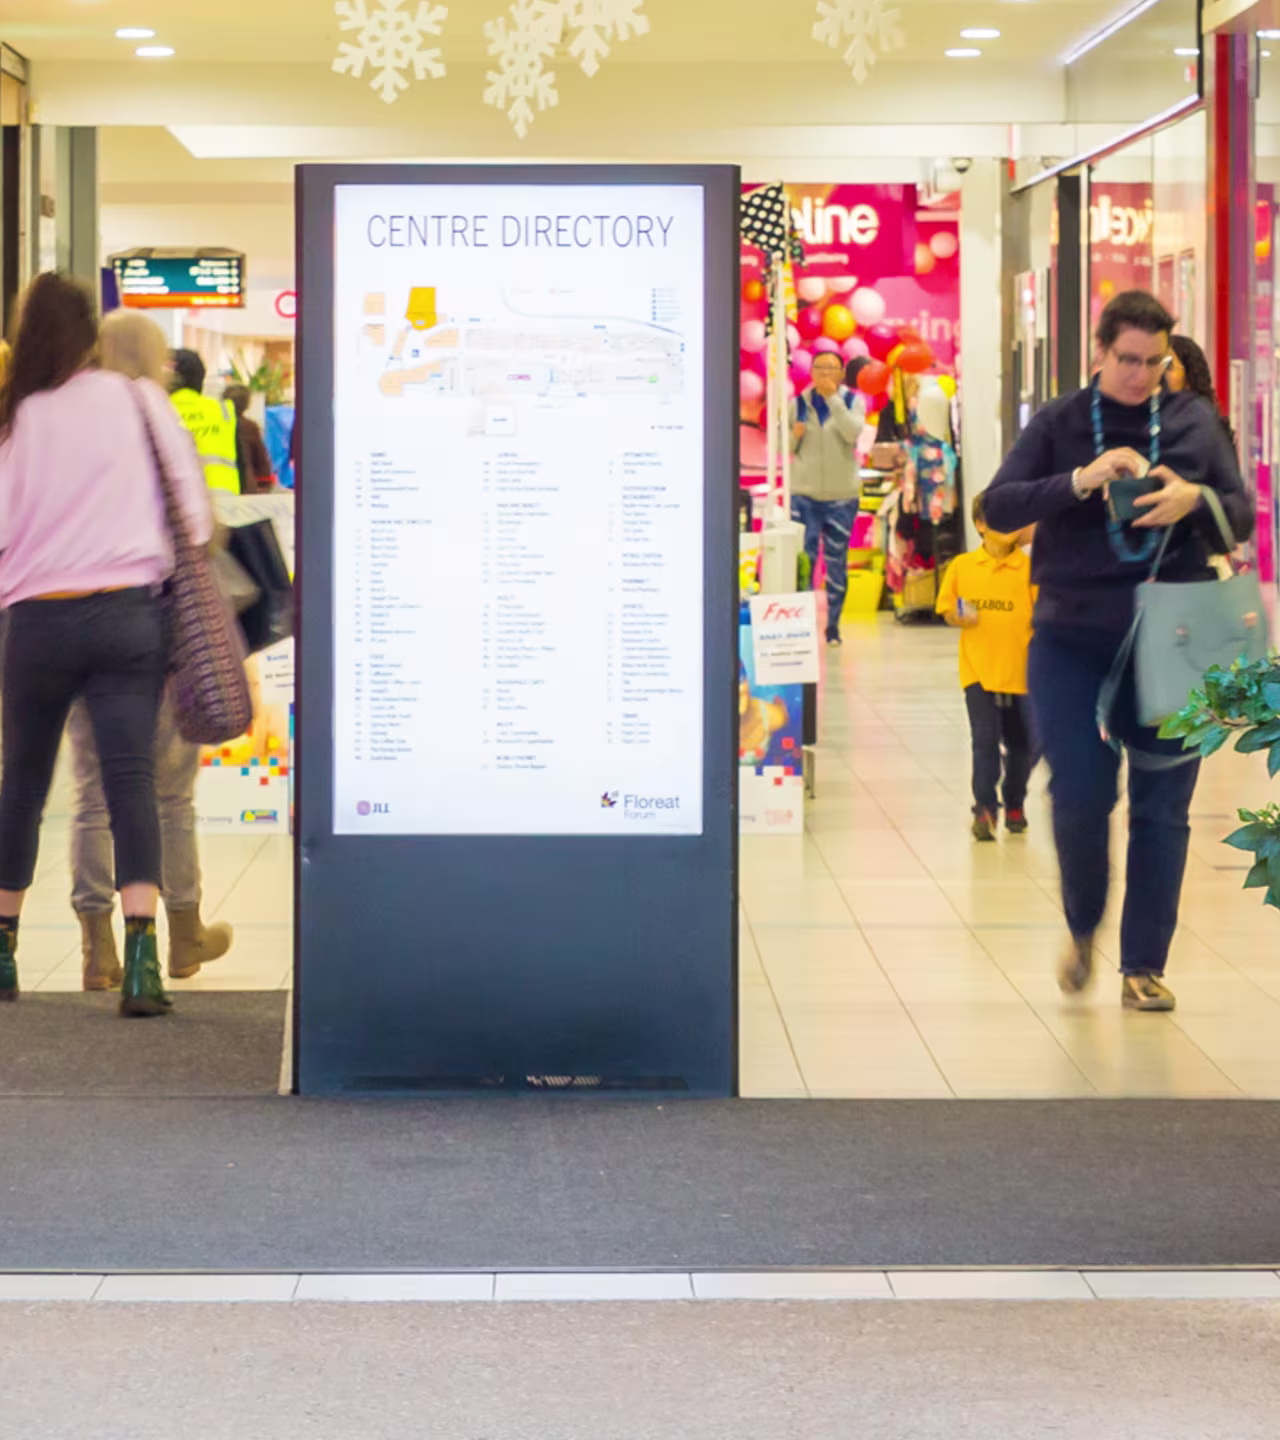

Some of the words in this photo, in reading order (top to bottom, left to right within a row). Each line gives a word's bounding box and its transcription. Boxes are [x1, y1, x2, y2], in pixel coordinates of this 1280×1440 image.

[367, 214, 489, 248] CENTRE
[501, 214, 675, 248] DIRECTORY
[623, 793, 681, 810] Floreat
